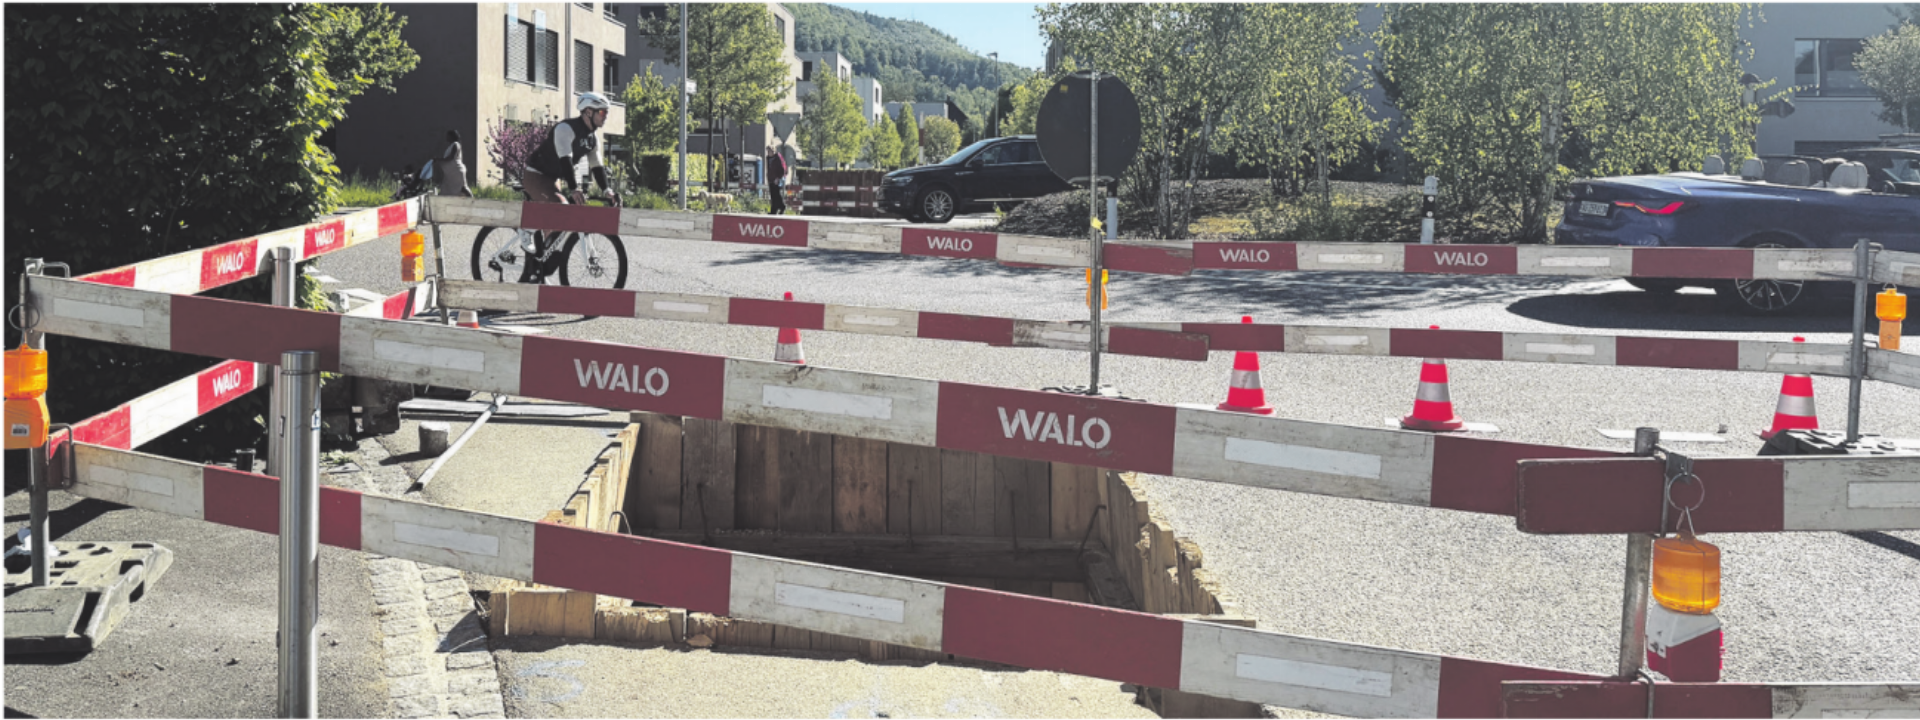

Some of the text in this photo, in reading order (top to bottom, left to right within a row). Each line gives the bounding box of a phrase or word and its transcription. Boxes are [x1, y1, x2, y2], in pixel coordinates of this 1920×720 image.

[315, 229, 335, 247] WALO
[739, 222, 785, 238] WALO
[926, 235, 973, 251] WALO
[217, 252, 244, 274] WALO
[1219, 249, 1270, 263] WALO
[1433, 252, 1489, 267] WALO
[213, 369, 242, 397] WALO
[573, 358, 670, 397] WALO
[997, 405, 1112, 450] WALO
